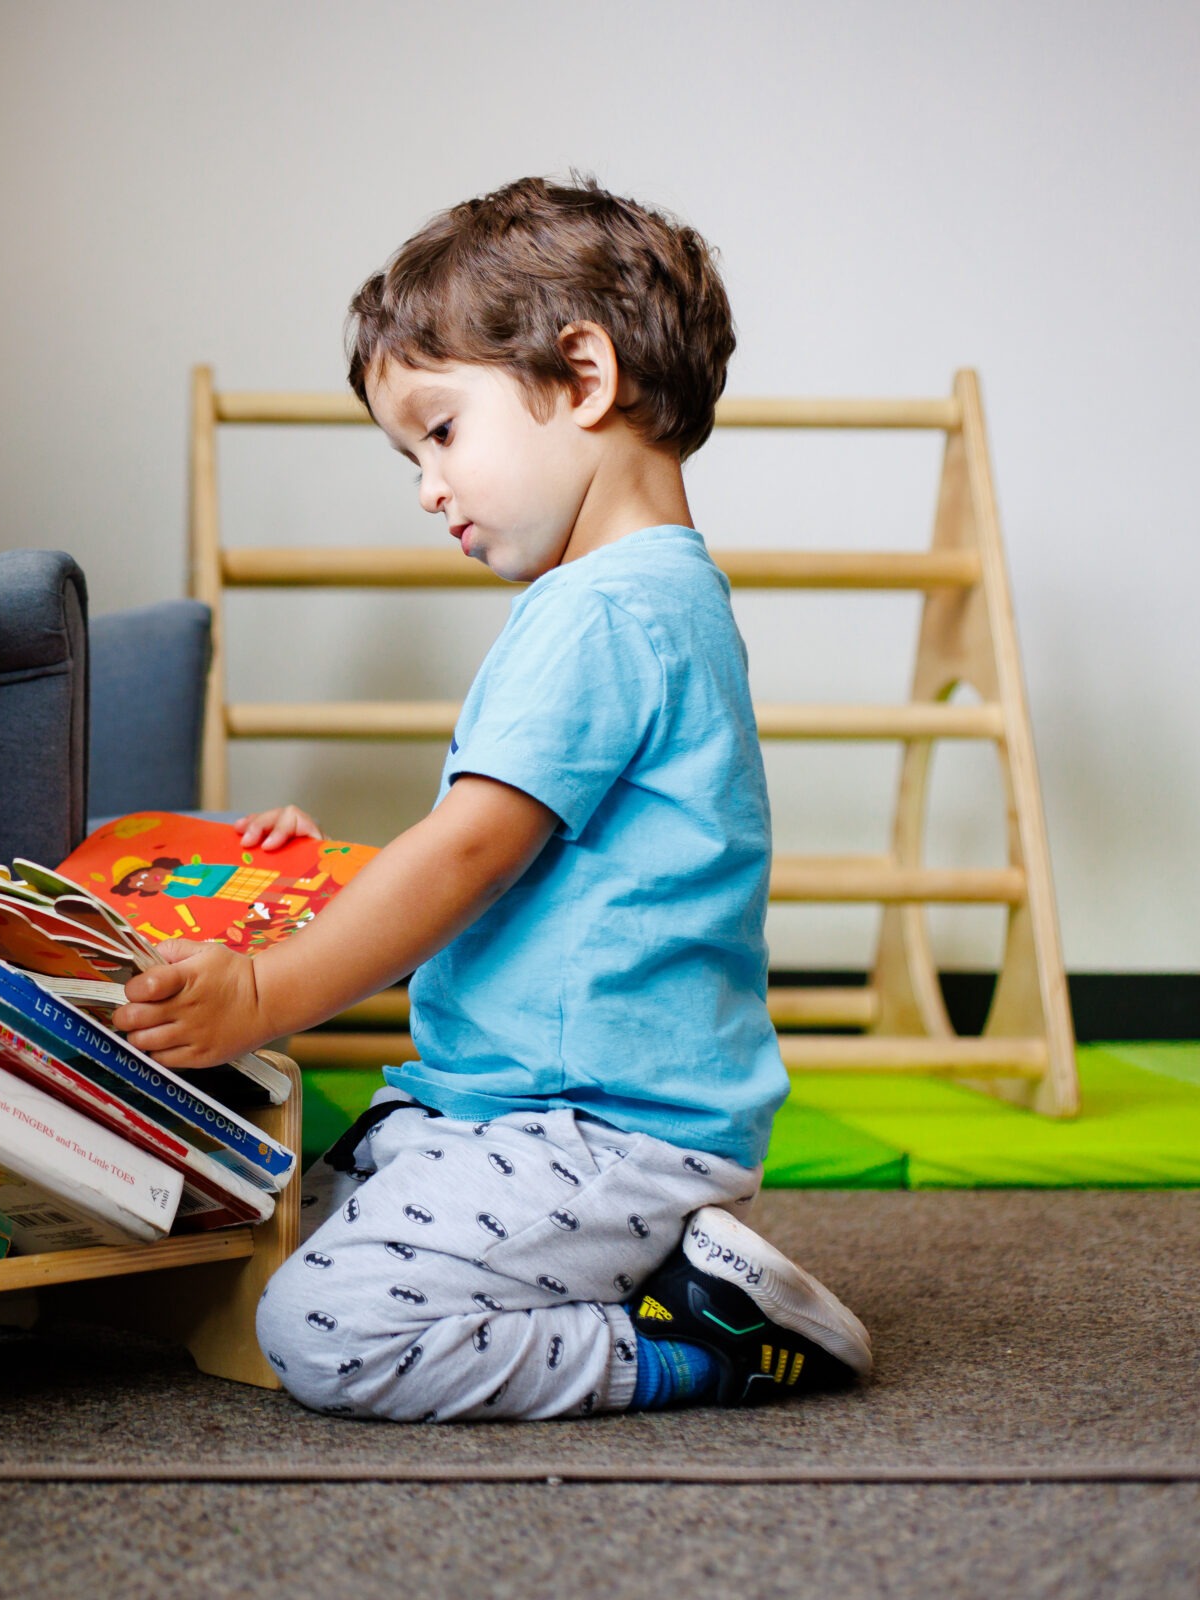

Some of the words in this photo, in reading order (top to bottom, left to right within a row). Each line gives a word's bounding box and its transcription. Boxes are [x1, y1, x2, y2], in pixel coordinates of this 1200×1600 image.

[34, 997, 73, 1031] LET'S
[77, 1025, 112, 1055] FIND
[115, 1049, 162, 1087] MOMO
[166, 1084, 248, 1144] OUTDOORS!
[12, 1107, 55, 1138] FINGERS
[55, 1135, 72, 1149] and
[72, 1142, 87, 1158] Ten
[88, 1152, 110, 1171] Little
[111, 1164, 136, 1186] TOES
